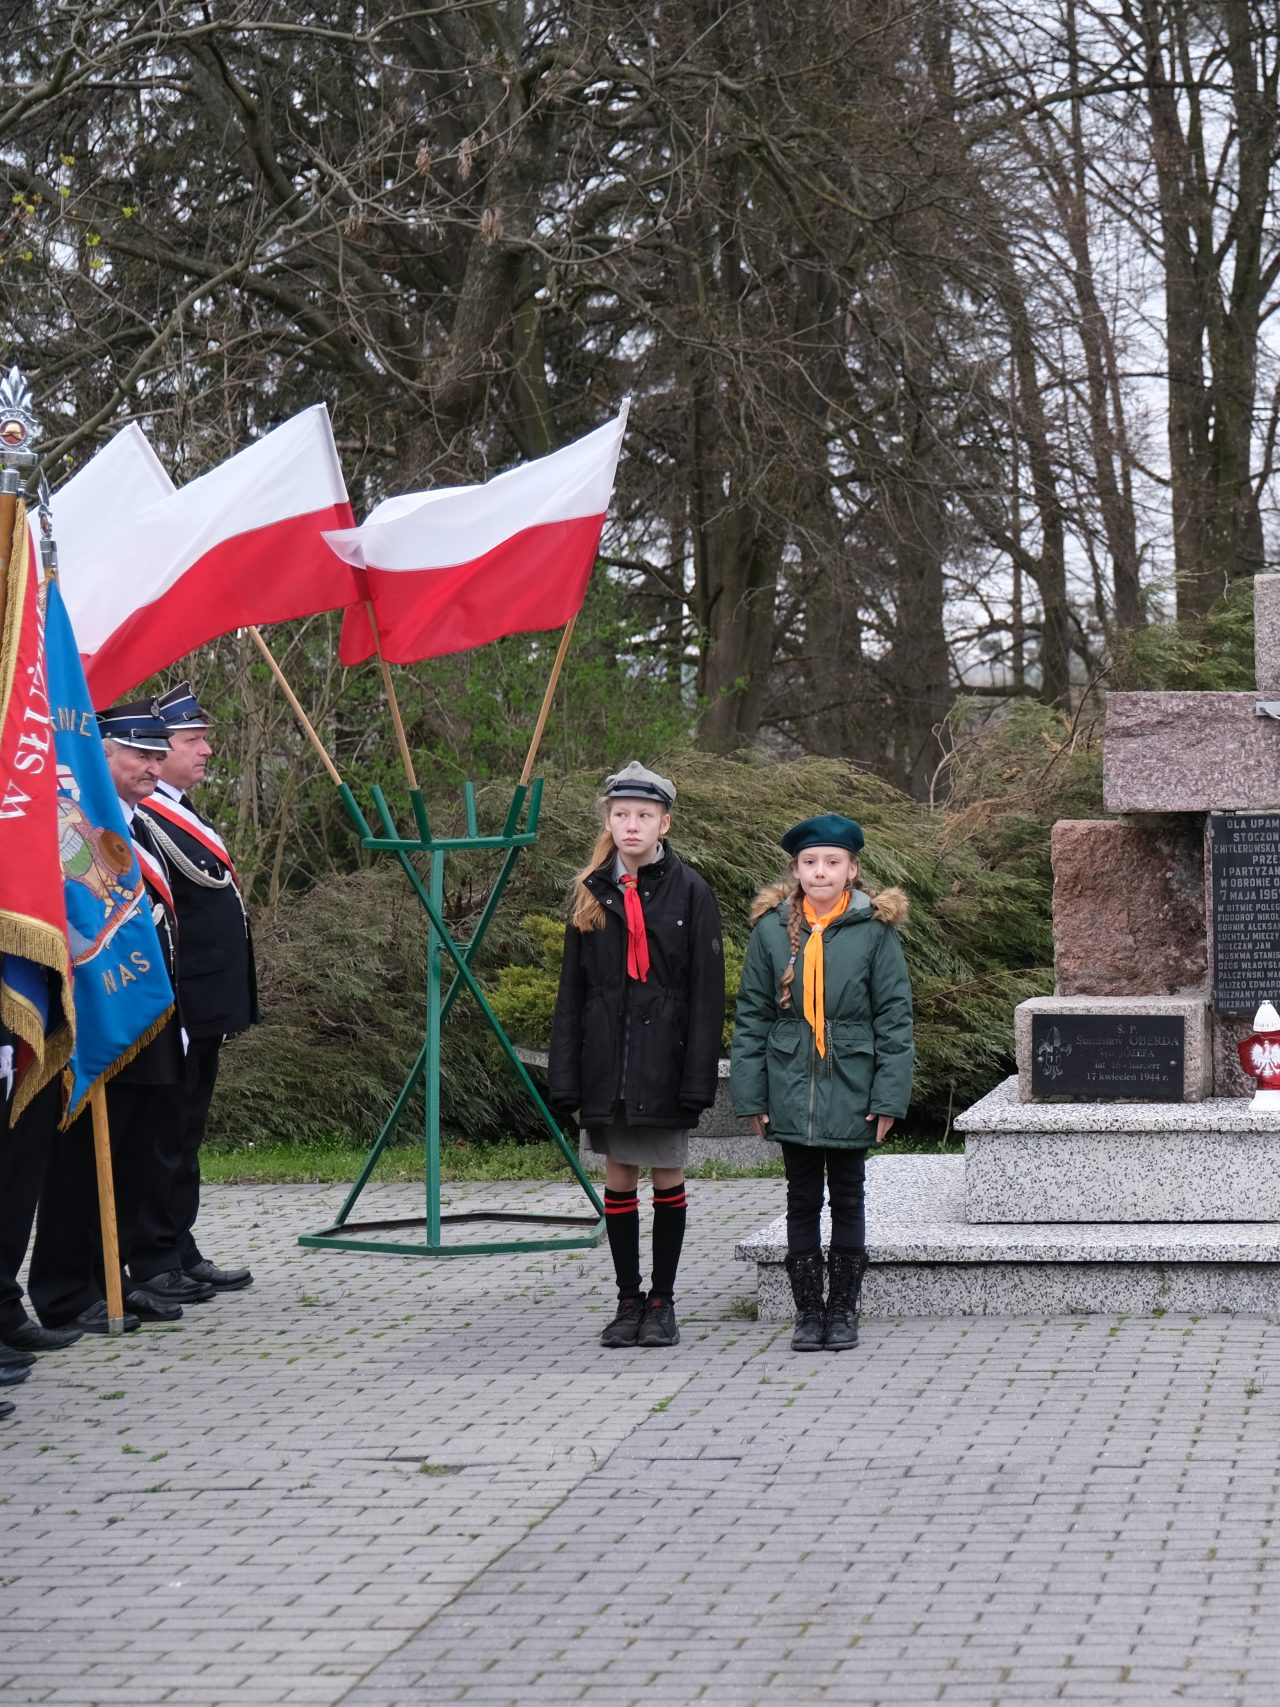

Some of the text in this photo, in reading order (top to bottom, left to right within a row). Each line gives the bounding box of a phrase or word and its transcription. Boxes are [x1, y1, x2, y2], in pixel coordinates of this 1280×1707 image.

[1227, 819, 1247, 829] DLA
[1220, 878, 1228, 888] W
[1230, 878, 1272, 888] OBRONIE
[1219, 889, 1227, 901] 7
[1229, 890, 1257, 901] MAJA
[1217, 903, 1224, 912] W
[1217, 913, 1256, 922] FIODOROF
[1255, 941, 1272, 950] JAN
[101, 951, 151, 996] NAS
[1218, 989, 1256, 999] NIEZNANY
[1218, 999, 1256, 1009] NIEZNANY
[1087, 1071, 1097, 1082] 17
[1139, 1071, 1160, 1082] 1944
